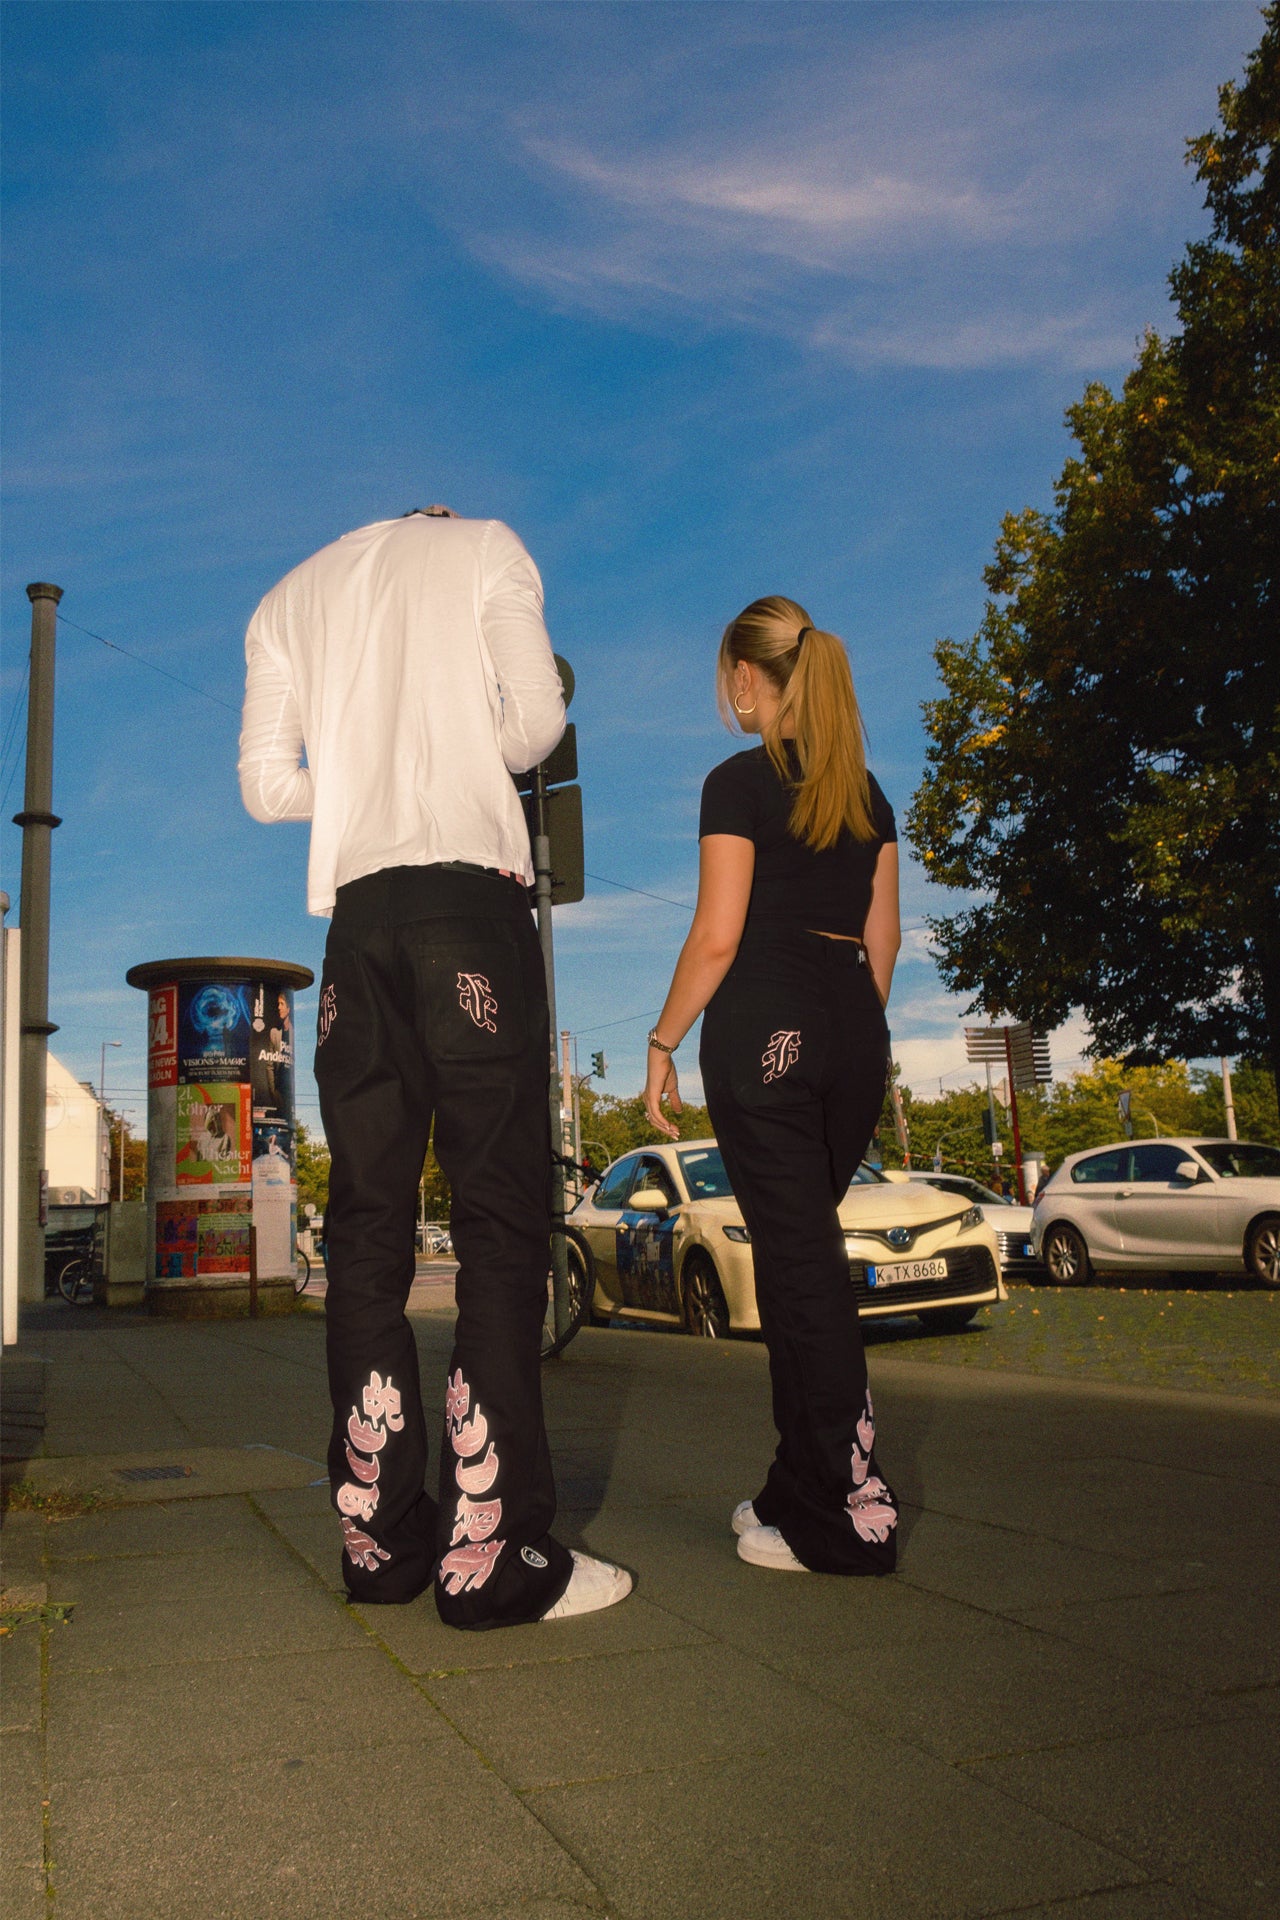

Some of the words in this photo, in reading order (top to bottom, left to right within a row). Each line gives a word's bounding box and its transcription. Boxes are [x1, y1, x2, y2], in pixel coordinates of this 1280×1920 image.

[183, 1058, 214, 1067] VISIONS
[877, 1269, 885, 1282] K
[894, 1266, 911, 1280] TX
[913, 1262, 944, 1278] 8686
